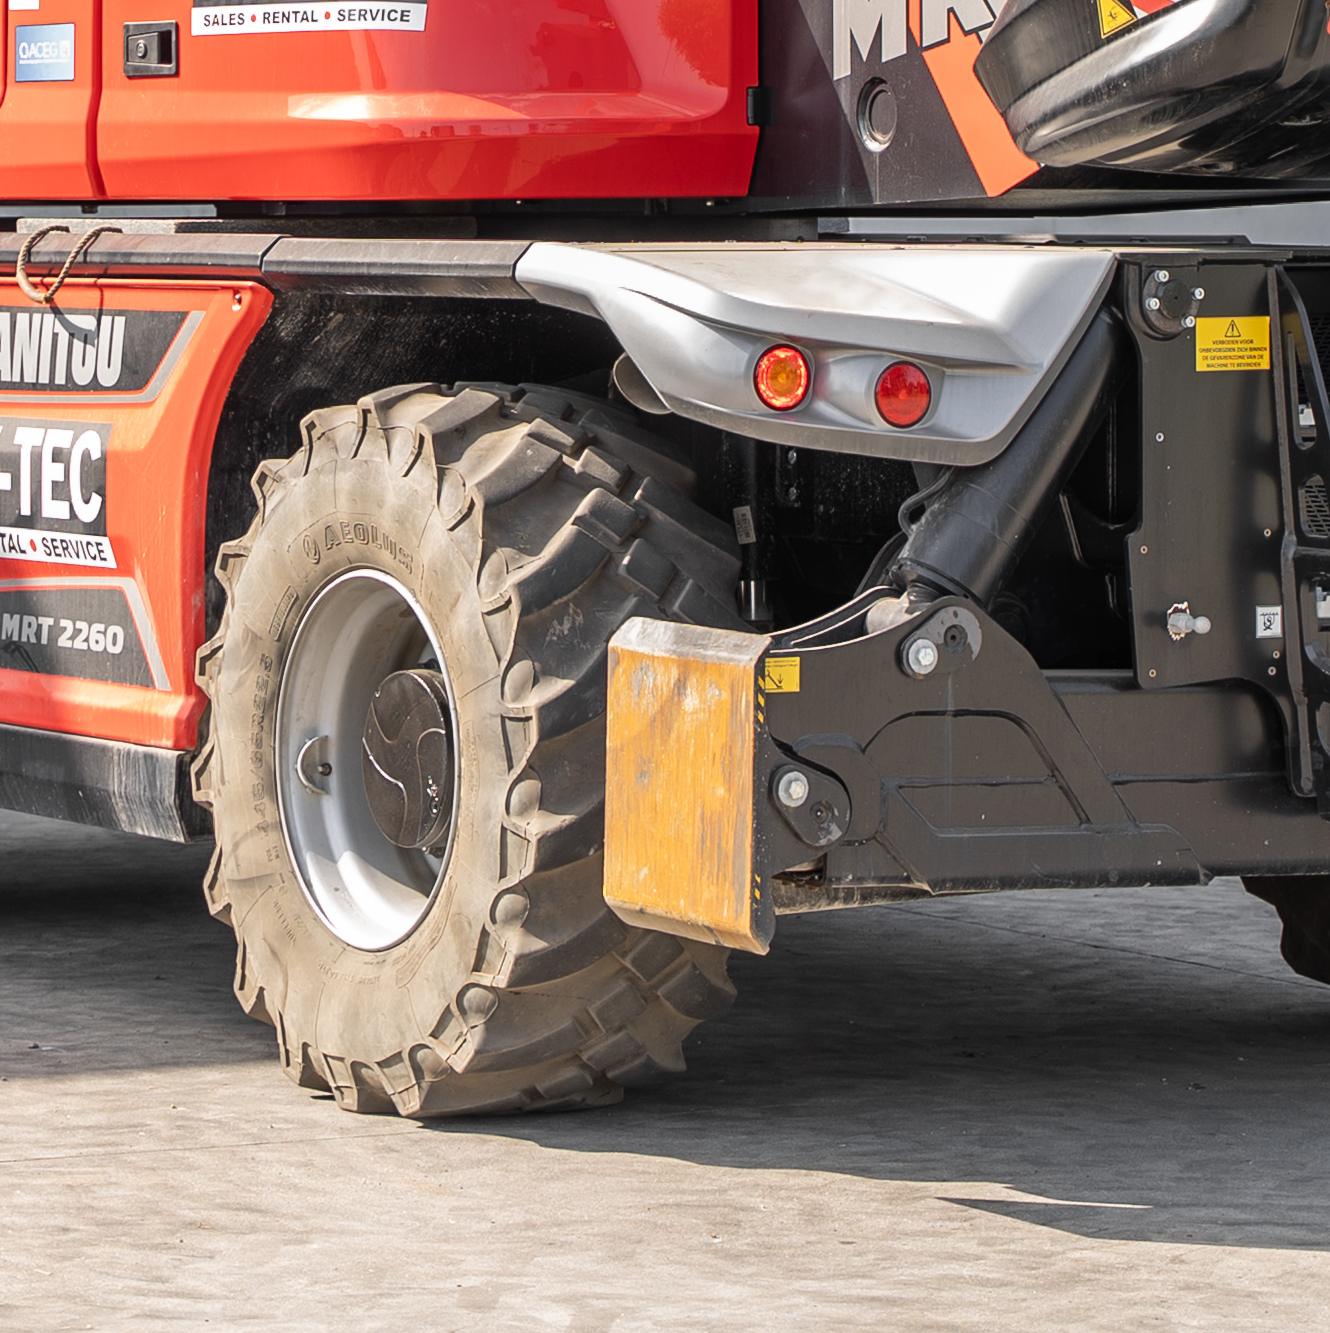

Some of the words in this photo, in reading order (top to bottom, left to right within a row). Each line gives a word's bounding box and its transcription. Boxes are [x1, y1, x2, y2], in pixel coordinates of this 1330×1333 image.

[203, 13, 245, 27] SALES
[263, 10, 319, 25] RENTAL
[337, 9, 411, 23] SERVICE
[41, 537, 108, 562] SERVICE
[1, 613, 55, 645] MRT
[57, 619, 124, 654] 2260
